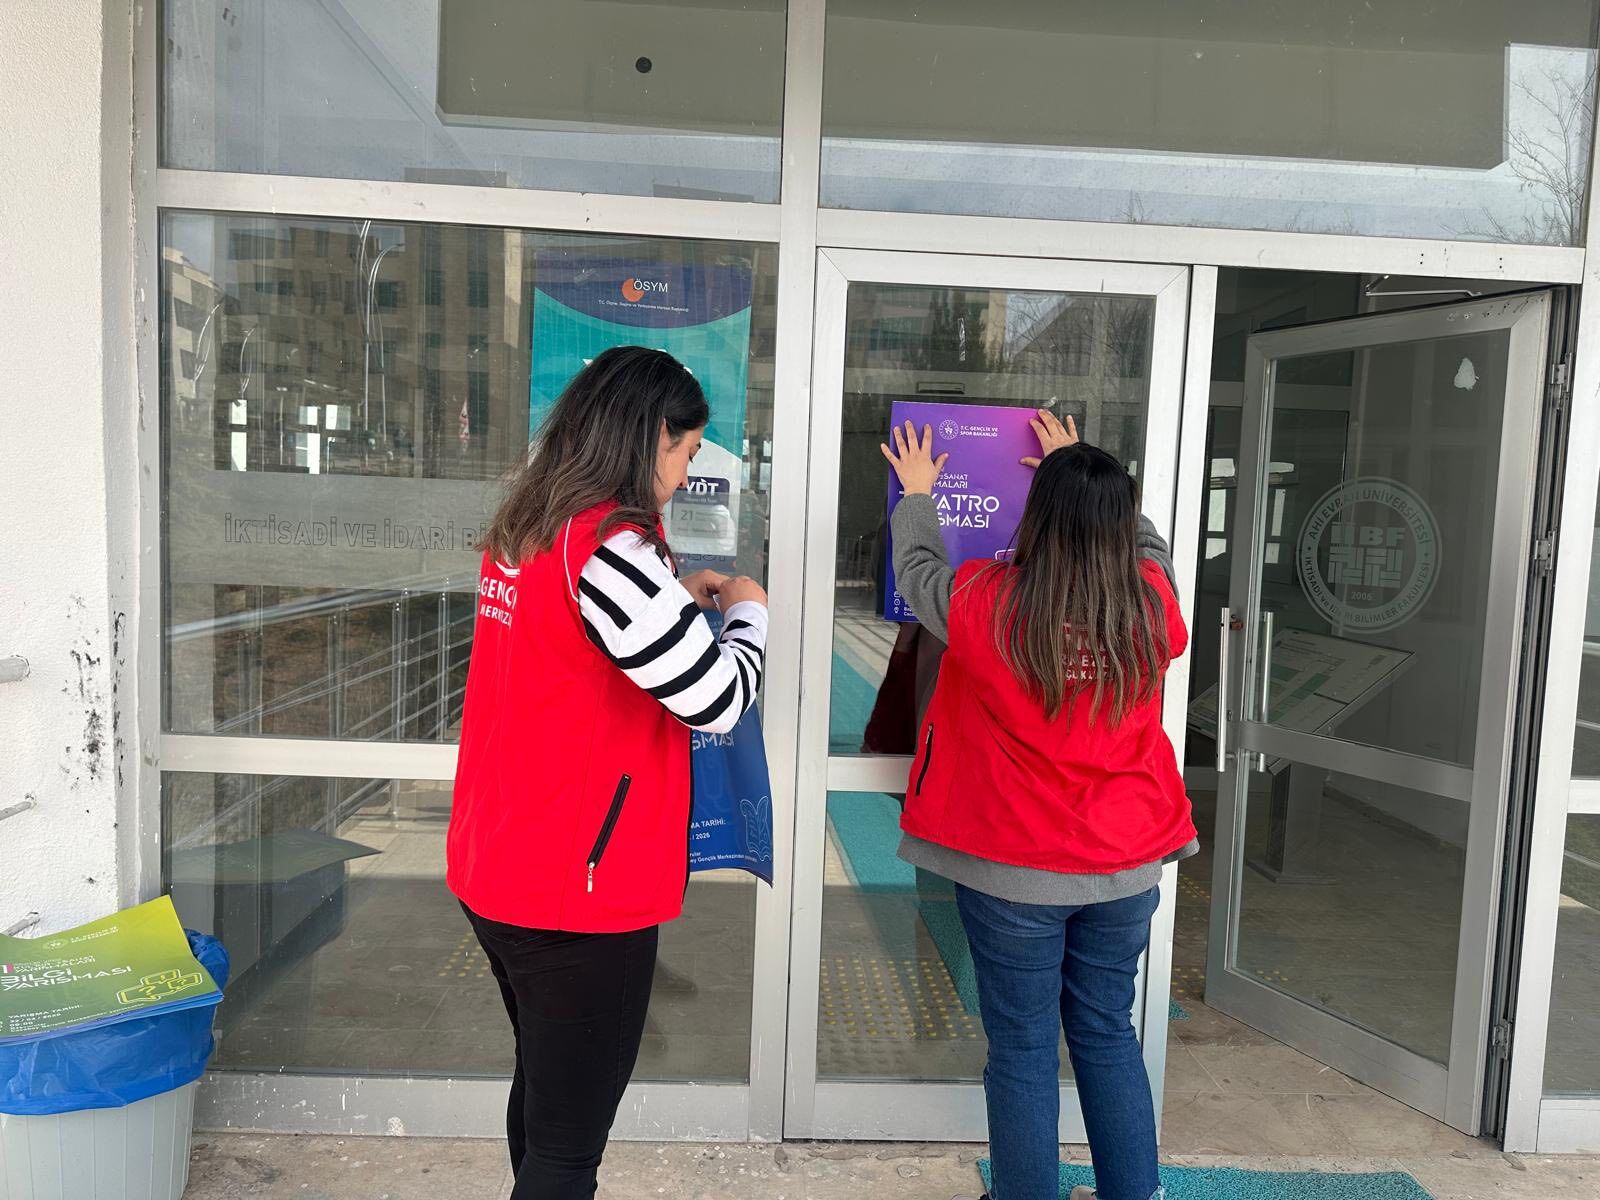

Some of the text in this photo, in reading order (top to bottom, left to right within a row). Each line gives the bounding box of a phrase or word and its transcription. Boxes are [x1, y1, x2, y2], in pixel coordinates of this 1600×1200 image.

[633, 277, 668, 293] ÖSYM
[933, 480, 968, 489] MALARI
[931, 493, 1000, 513] ATRO
[224, 512, 338, 546] İKTİSADİ
[343, 522, 377, 548] VE
[383, 518, 454, 551] İDARİ
